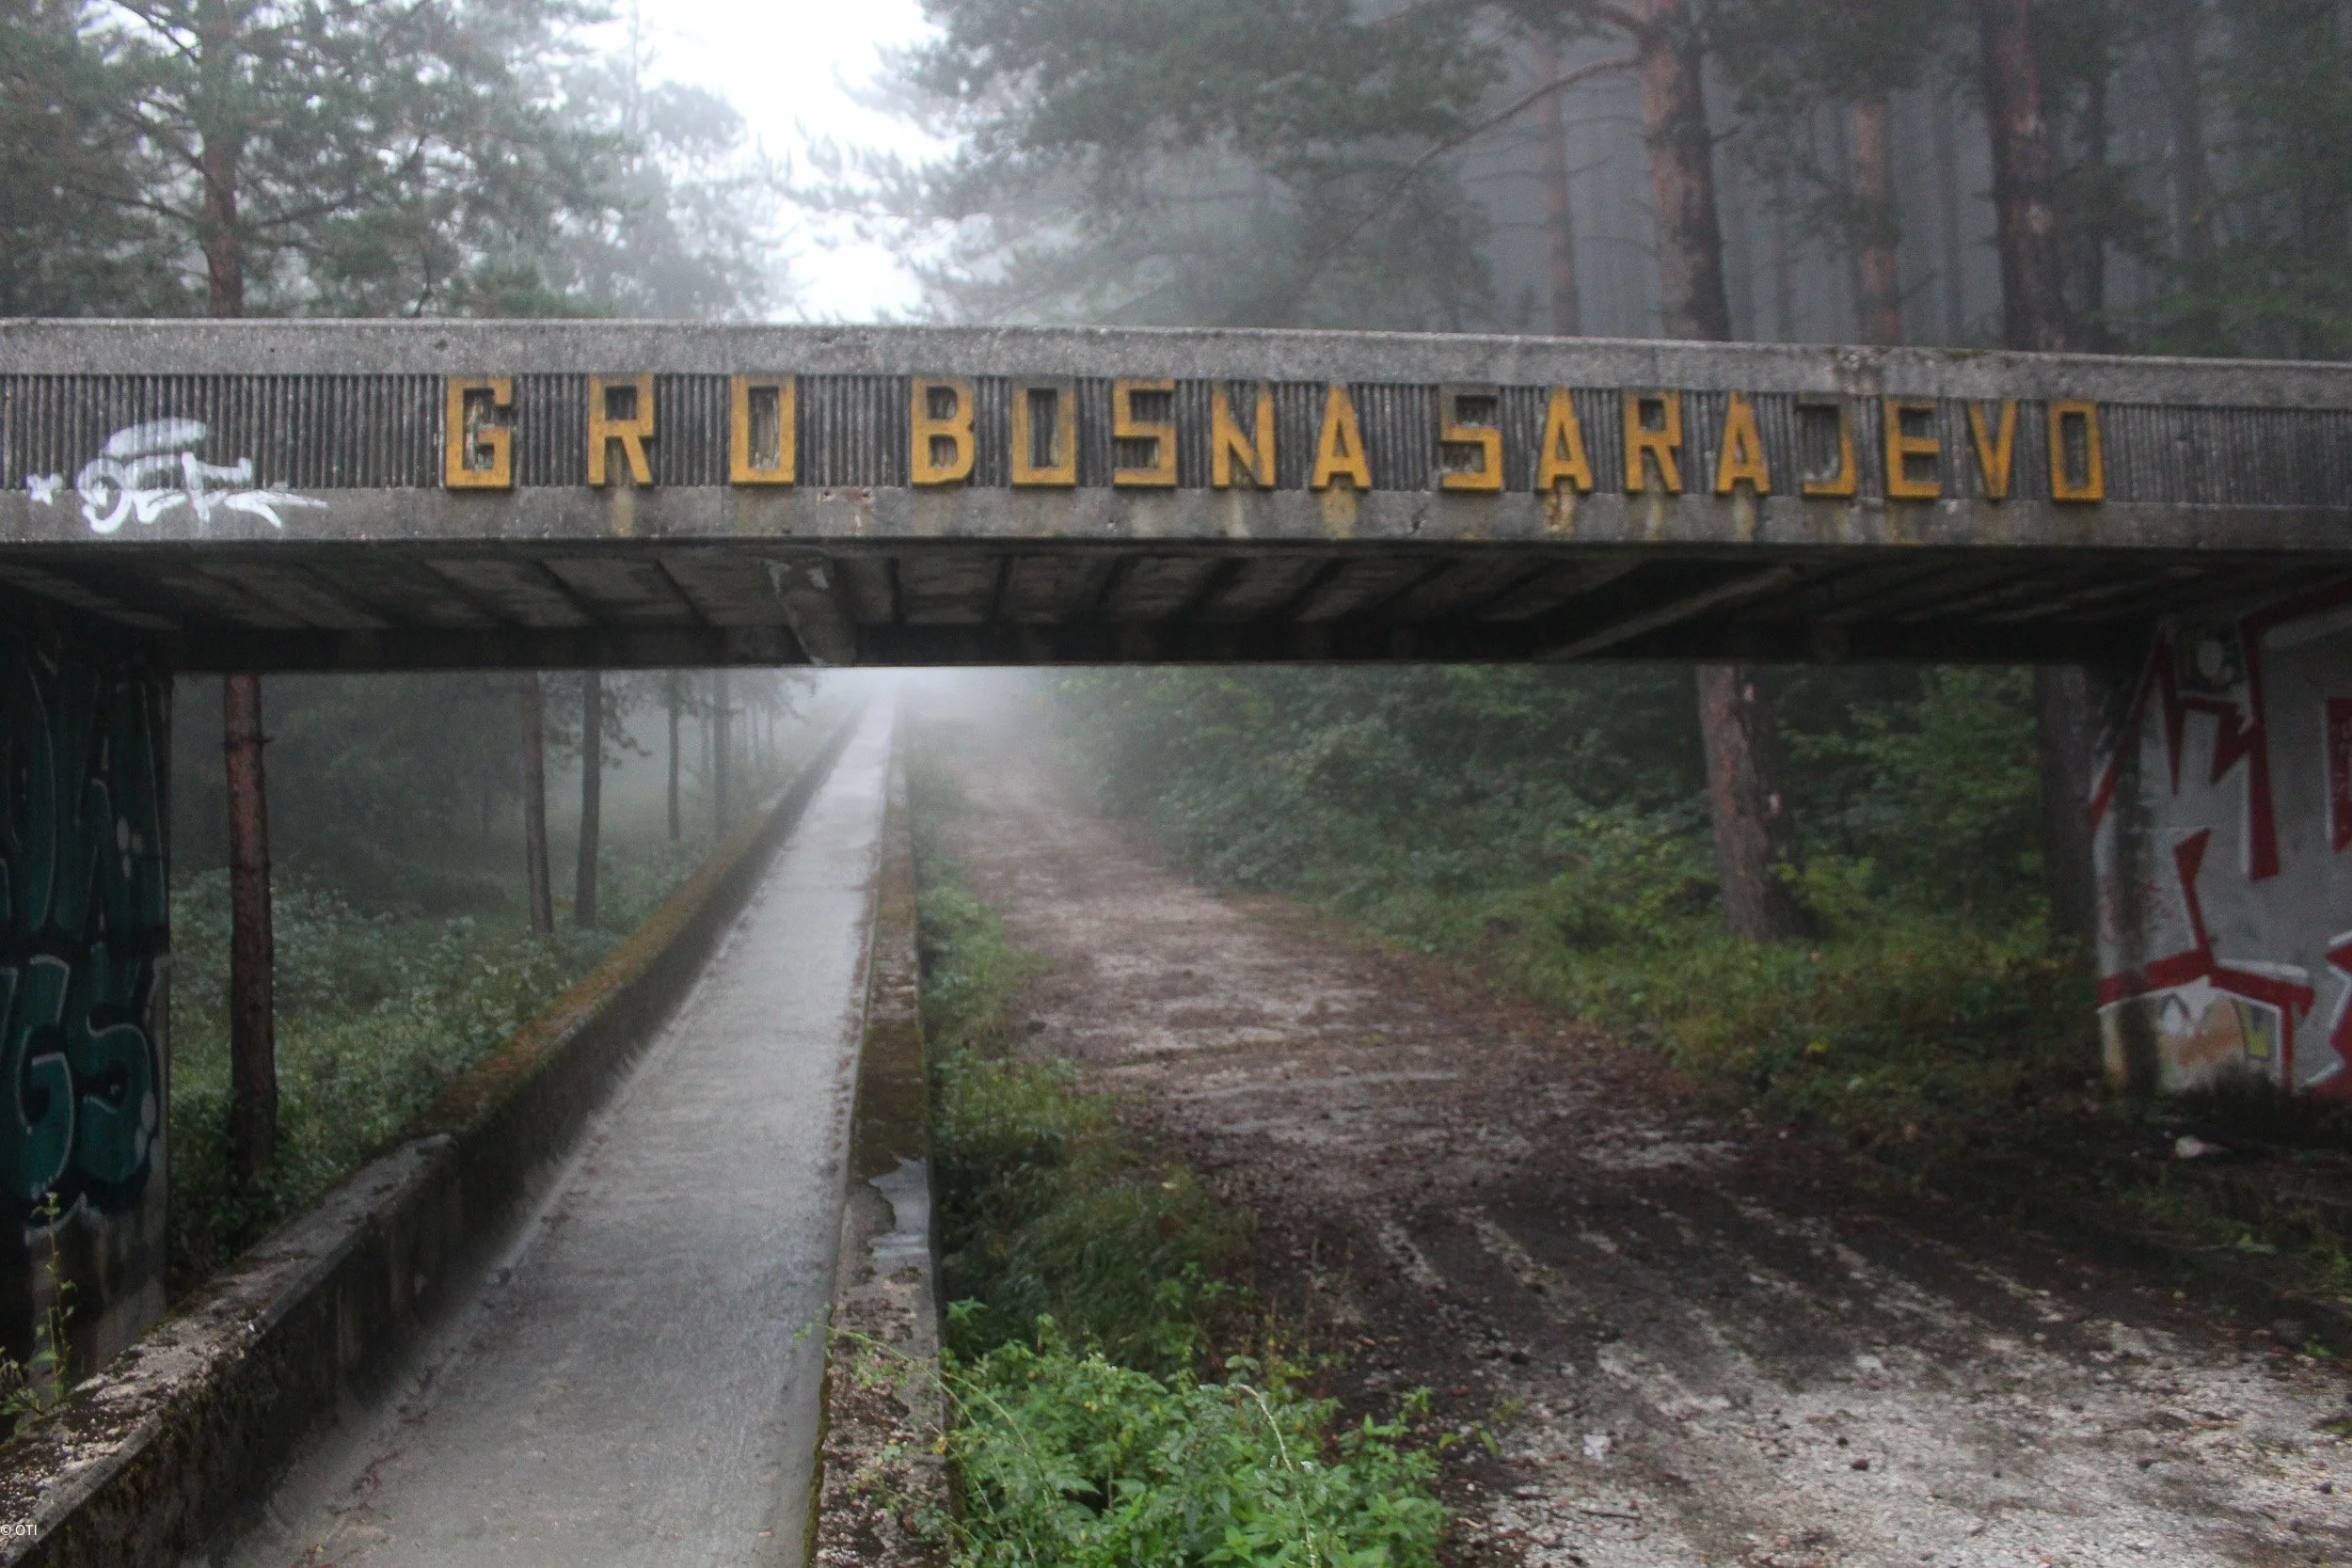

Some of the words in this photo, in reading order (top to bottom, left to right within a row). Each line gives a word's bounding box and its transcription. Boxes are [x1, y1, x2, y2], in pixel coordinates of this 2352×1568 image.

[446, 374, 796, 488] GRO
[911, 376, 1373, 490] BOSNA
[1438, 384, 2105, 502] SARAJEVO
